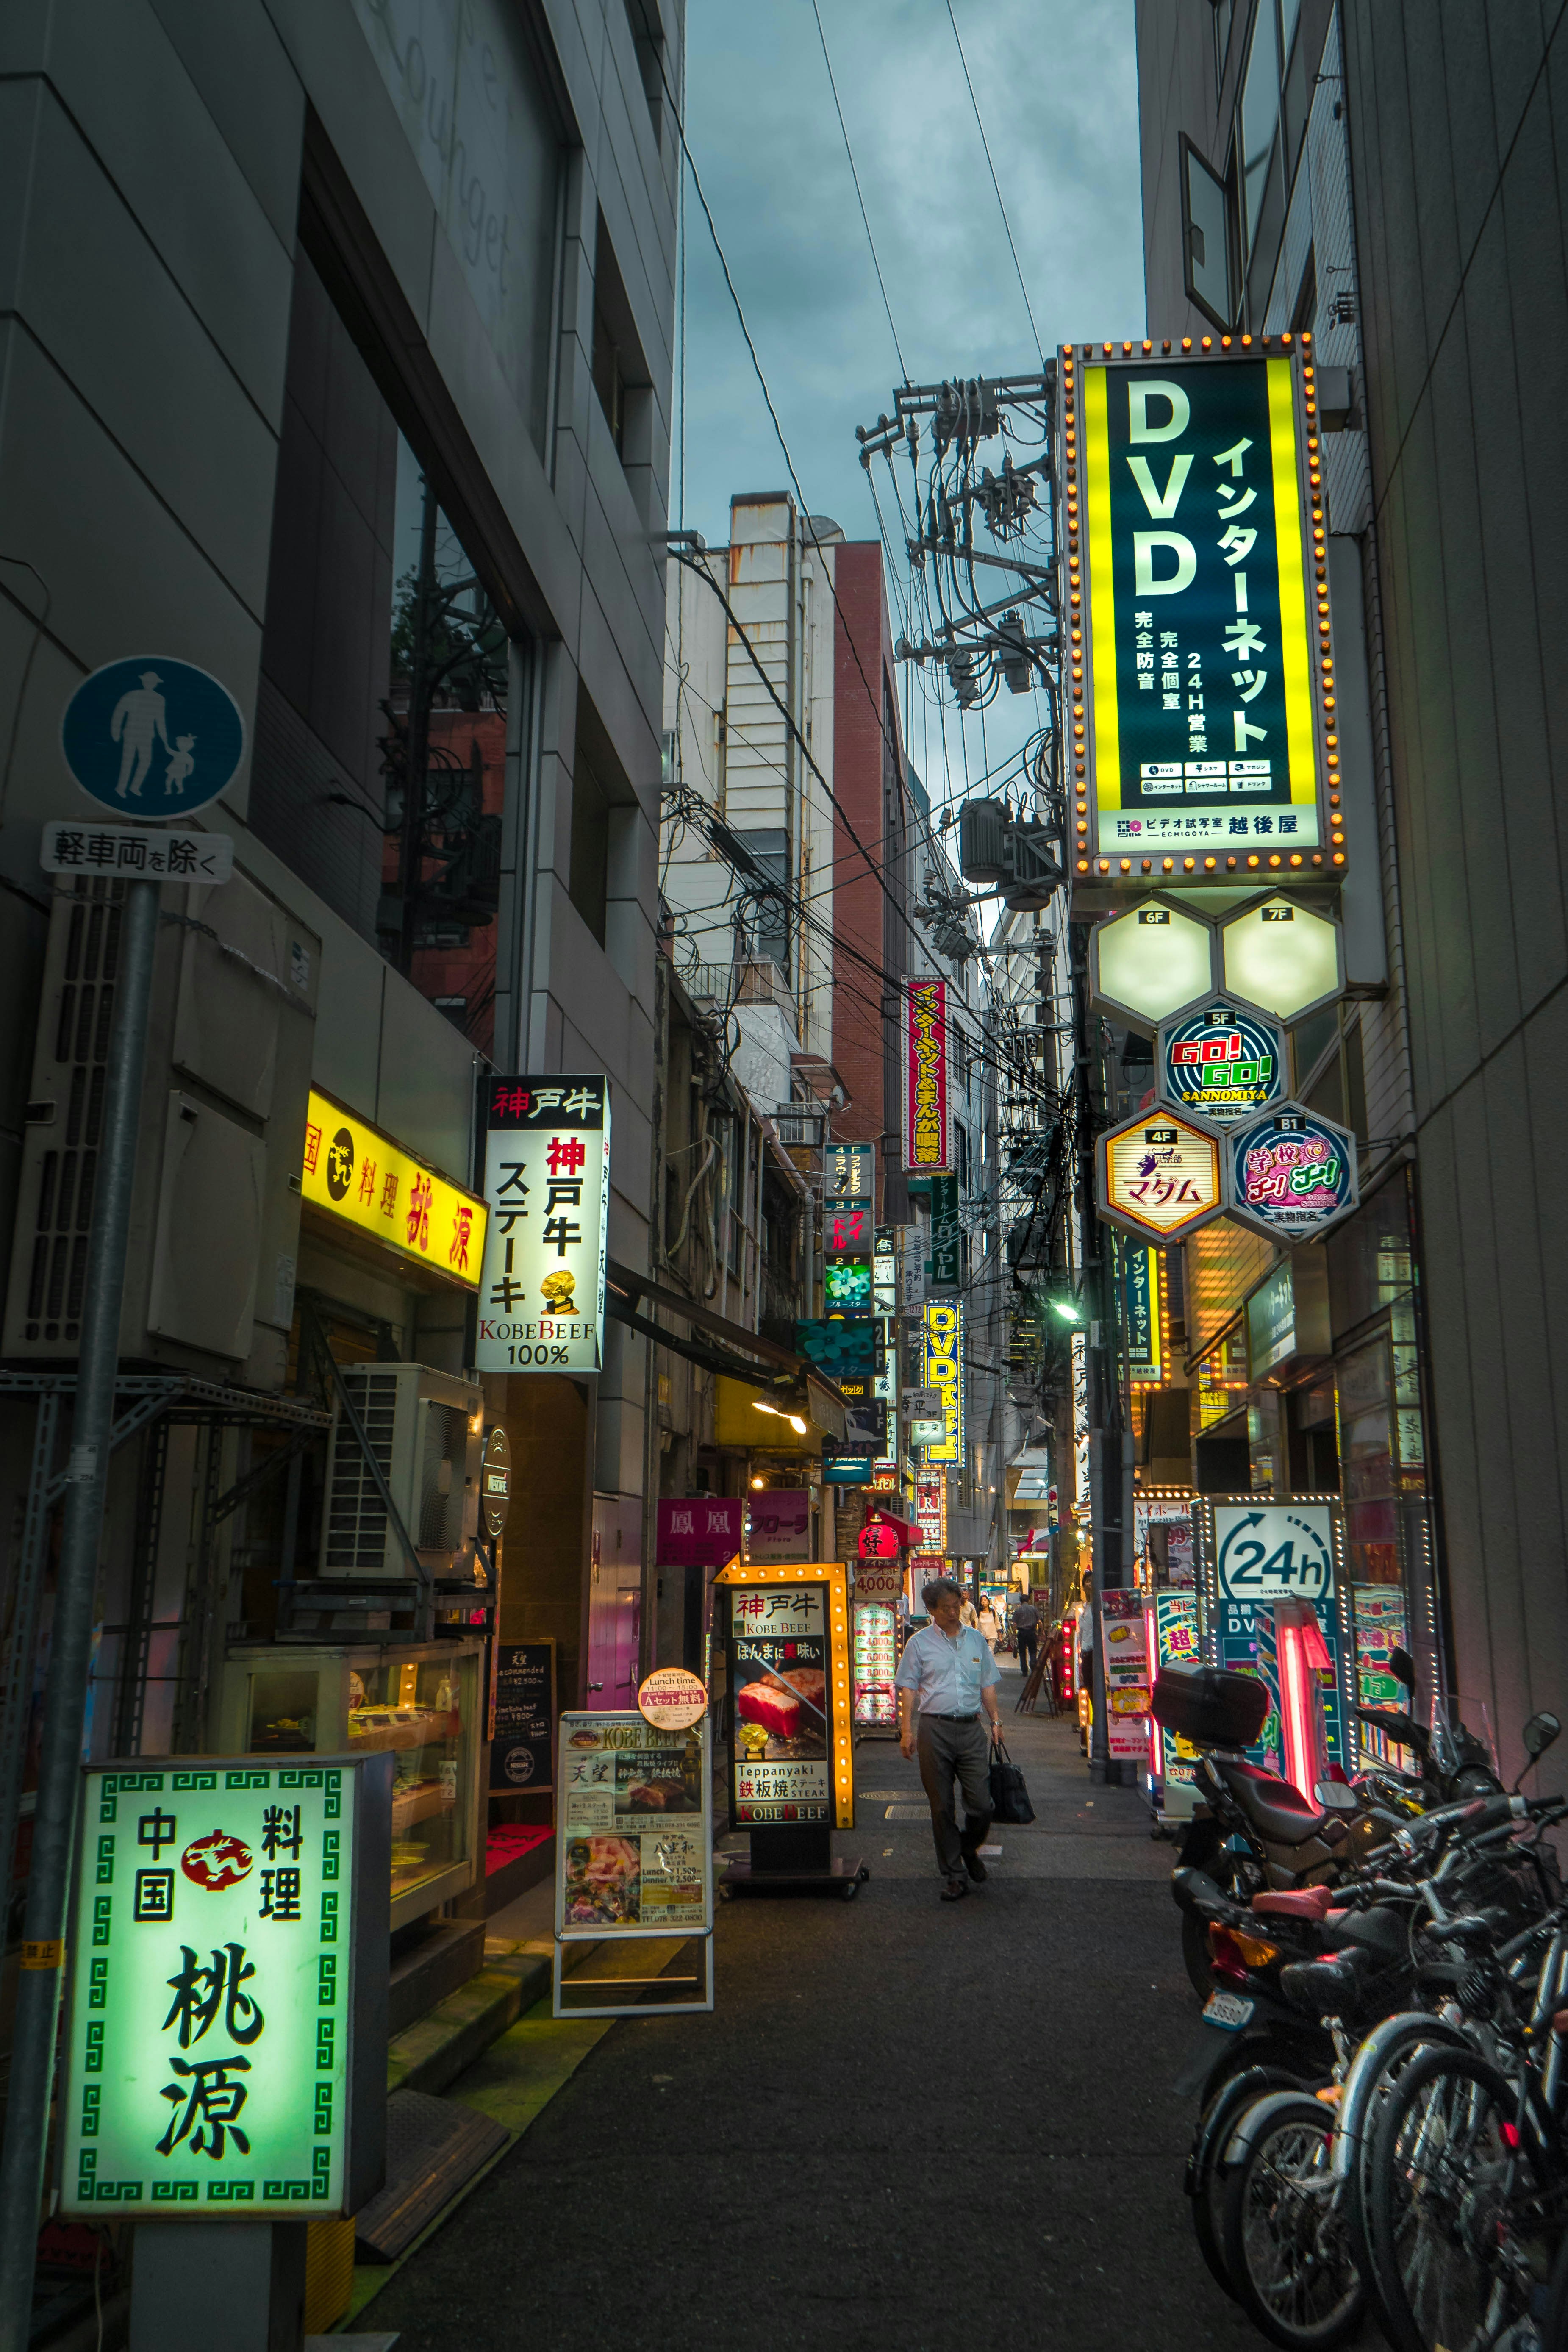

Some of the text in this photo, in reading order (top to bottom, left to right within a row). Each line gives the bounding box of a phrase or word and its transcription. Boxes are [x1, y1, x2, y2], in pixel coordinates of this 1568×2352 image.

[1126, 380, 1197, 596] DVD
[1213, 437, 1267, 752] インターネット
[1135, 611, 1154, 690] 完全防音
[1160, 632, 1181, 711] 完全個室
[1187, 653, 1207, 753] 24H営業
[1146, 815, 1298, 835] ビデオ試写室 越後屋
[53, 830, 215, 875] 軽車両を除く
[1146, 912, 1163, 923] 6F
[1269, 909, 1287, 920] 7F
[1212, 1013, 1229, 1025] 5F
[1171, 1033, 1243, 1065] GO!
[1201, 1055, 1273, 1087] GO!
[491, 1086, 602, 1121] 神戸牛
[1182, 1089, 1268, 1101] SANNOMIYA
[1208, 1108, 1243, 1116] 実物指名
[1281, 1119, 1298, 1130] B1
[1152, 1132, 1171, 1142] 4F
[542, 1137, 586, 1257] 神戸牛
[1123, 1176, 1204, 1207] マダム
[357, 1156, 399, 1219] 料理
[406, 1171, 473, 1272] 桃源
[1274, 1211, 1318, 1222] 実物指名
[489, 1162, 530, 1314] ステーキ
[1132, 1249, 1147, 1345] インターネット
[508, 1344, 569, 1366] 100%
[924, 1497, 934, 1508] R
[1229, 1541, 1321, 1585] 24h
[856, 1577, 900, 1594] 4,000円
[735, 1592, 819, 1620] 神戸牛
[746, 1622, 811, 1634] KOBE BEEF
[860, 1617, 889, 1626] アイドル
[1168, 1628, 1192, 1652] 超
[737, 1642, 820, 1661] ほんまに美味い
[644, 1694, 702, 1705] Aセット無料
[602, 1728, 681, 1749] KOBE BEEF
[571, 1764, 609, 1783] 天望
[738, 1765, 814, 1778] Teppanyaki
[738, 1778, 826, 1798] 鉄板焼 ステーキ
[791, 1789, 826, 1798] STEAK
[133, 1806, 177, 1923] 中国
[258, 1803, 304, 1922] 料理
[155, 1941, 264, 2160] 桃源
